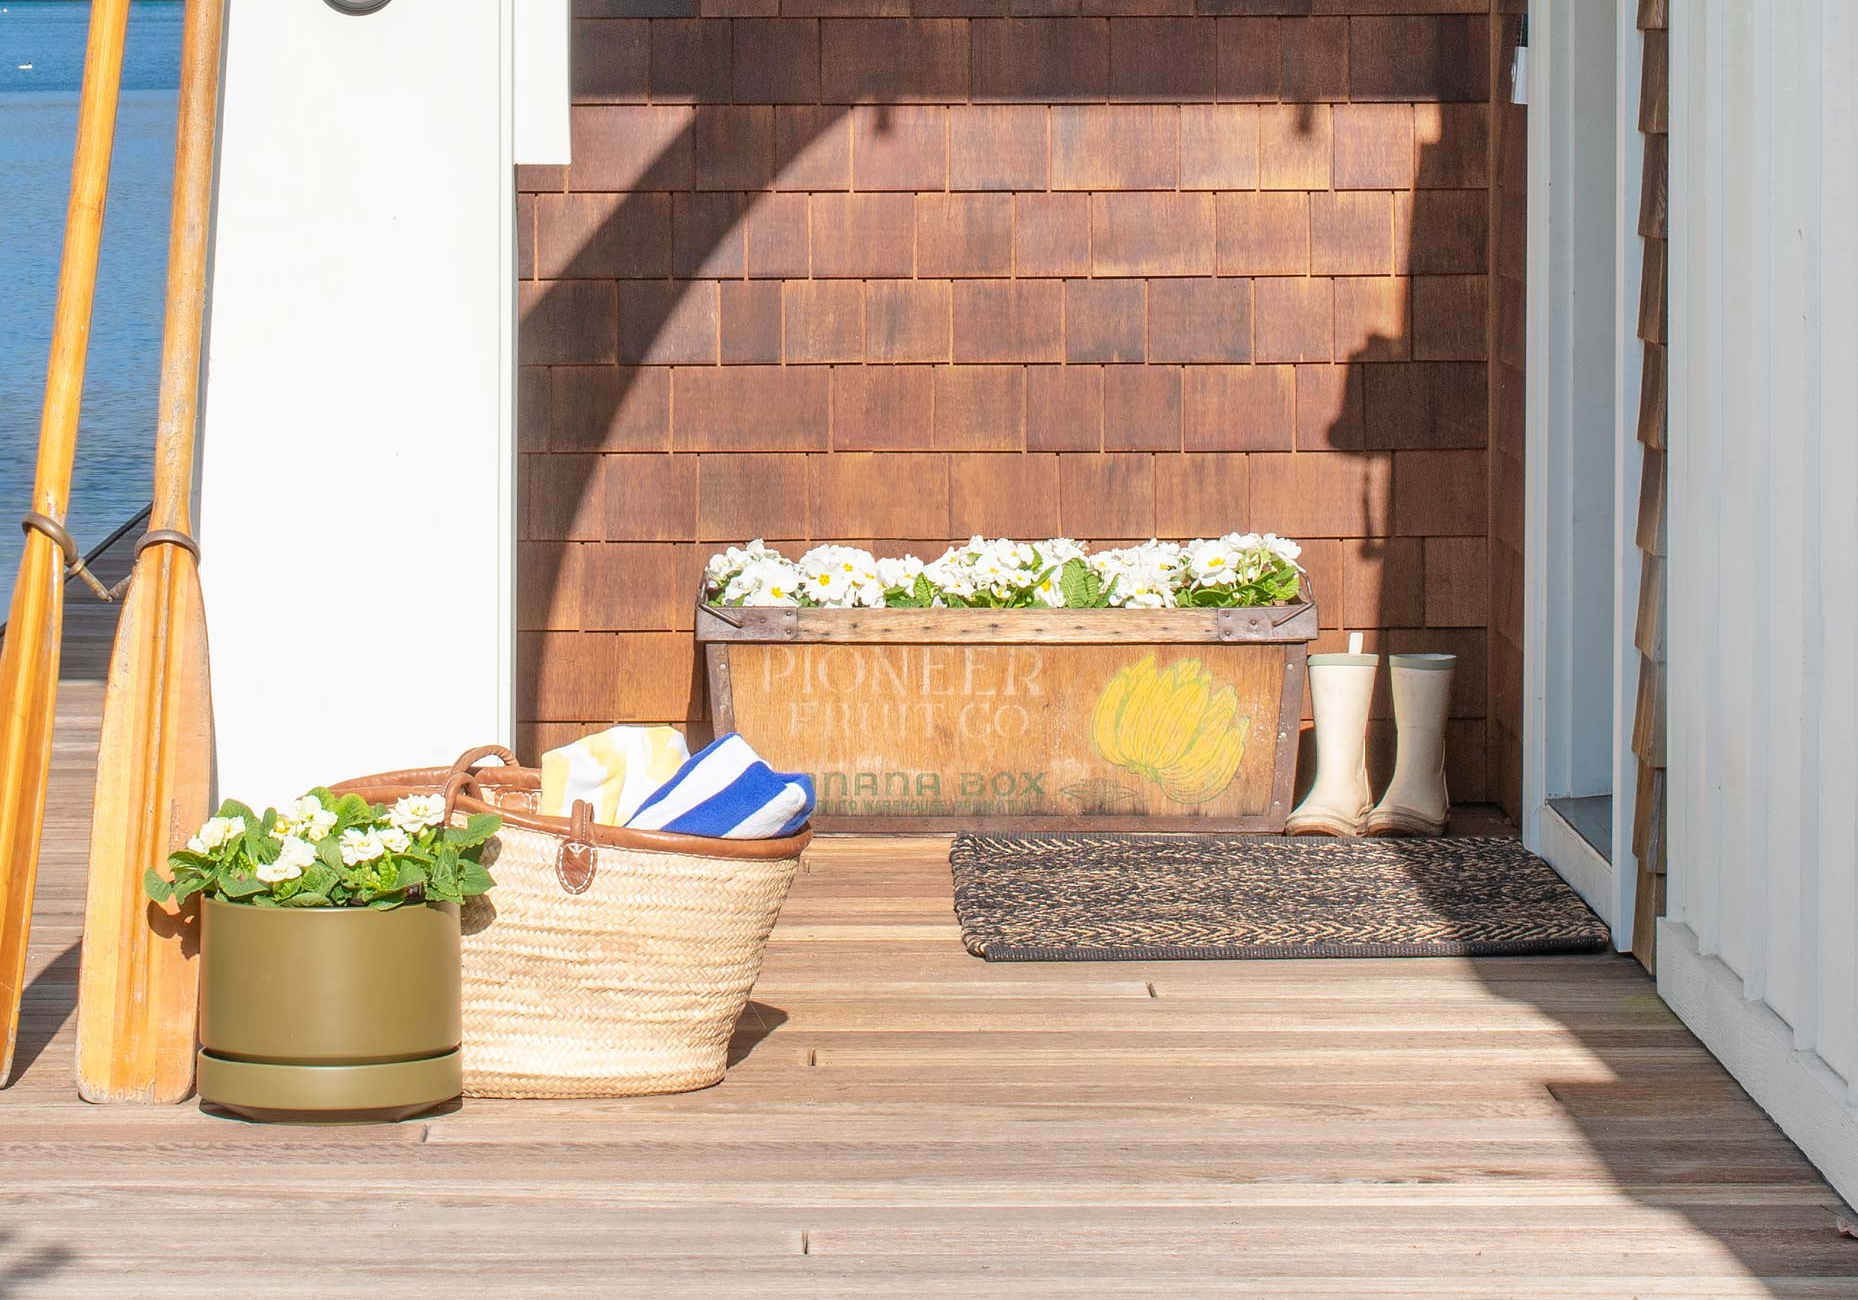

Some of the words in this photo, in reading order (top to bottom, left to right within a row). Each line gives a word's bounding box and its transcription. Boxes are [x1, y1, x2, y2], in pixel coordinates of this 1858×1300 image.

[763, 646, 1045, 696] PIONEER
[789, 700, 945, 739] FRUIT
[811, 771, 941, 797] NANA
[960, 771, 1047, 797] BOX
